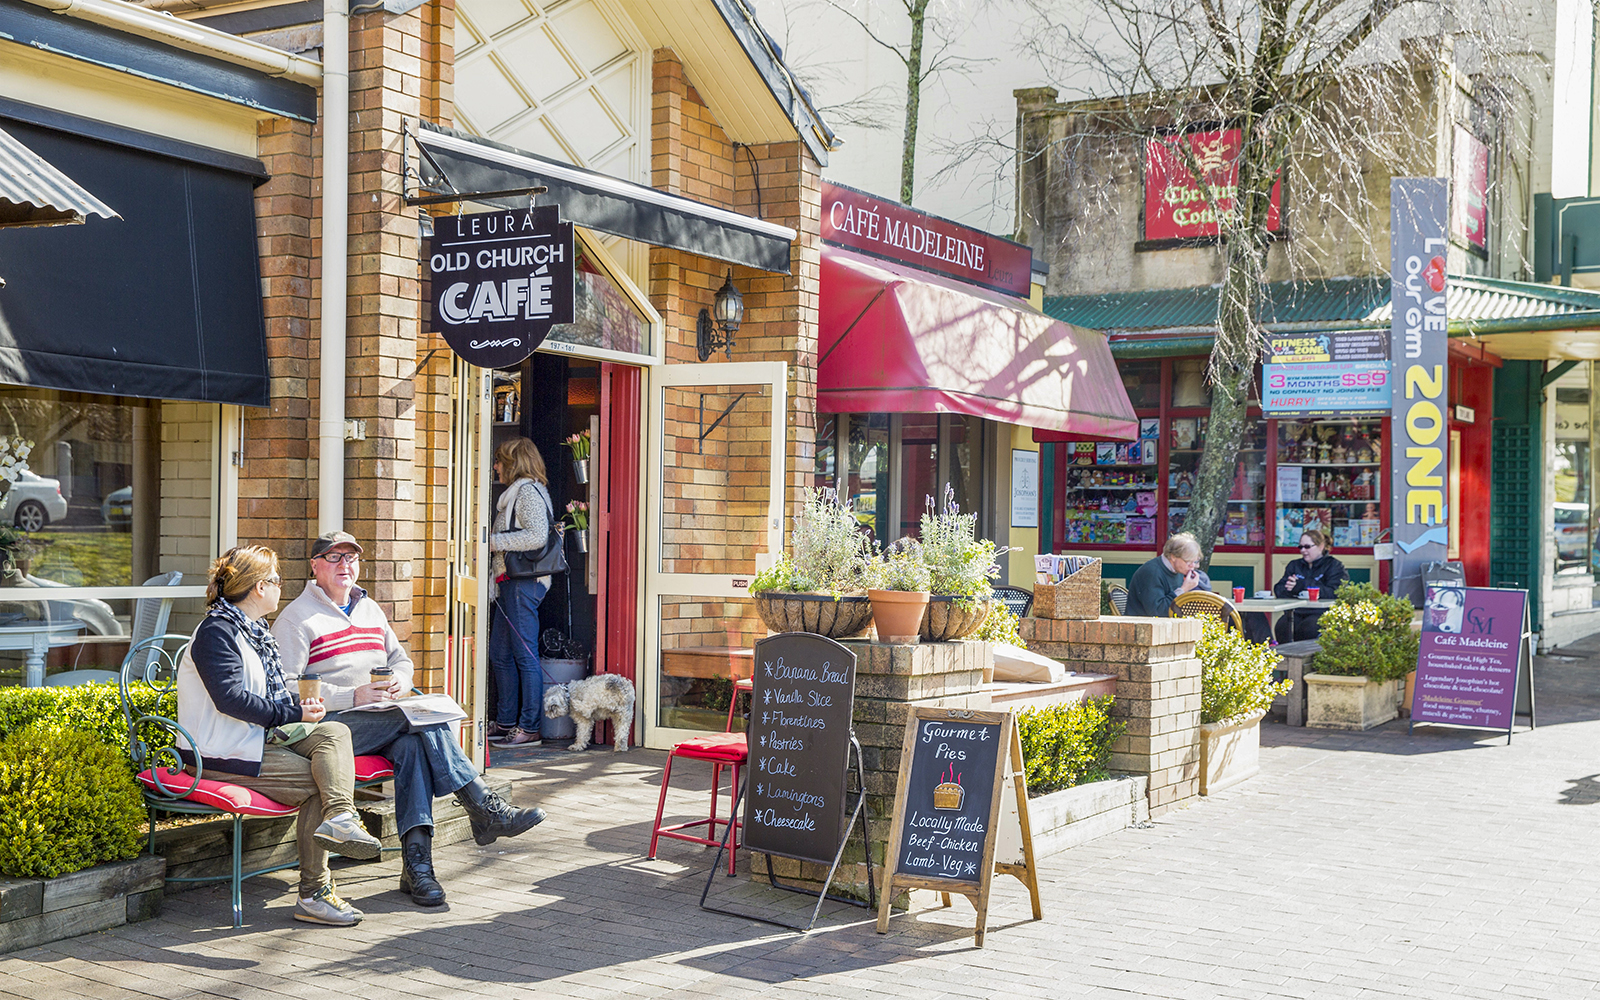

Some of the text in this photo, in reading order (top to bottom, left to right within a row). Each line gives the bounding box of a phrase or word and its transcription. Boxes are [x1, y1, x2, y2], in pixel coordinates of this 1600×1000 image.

[457, 213, 534, 236] LEURA
[830, 200, 1014, 284] CAFÉ MADELEINE Leura
[430, 244, 564, 272] OLD CHURCH
[439, 264, 552, 324] CAFÉ
[1272, 338, 1316, 348] FITNESS
[1294, 346, 1324, 355] ZONE
[1270, 375, 1286, 388] 3
[1342, 373, 1386, 387] $99
[1270, 397, 1315, 407] HURRY!
[1406, 364, 1443, 524] ZONE
[1434, 635, 1508, 649] Café Madeleine
[774, 656, 849, 685] Banana Bread
[1425, 674, 1454, 684] Legendary
[774, 688, 833, 707] Vanilla Slice
[772, 710, 826, 730] Florentines
[769, 730, 803, 751] Pastries
[922, 722, 990, 743] Gourmet
[935, 742, 967, 760] Pies
[767, 756, 796, 777] Cake
[767, 782, 825, 812] Lamingtons
[764, 809, 816, 831] Cheesecake
[910, 811, 984, 835] Locally Made
